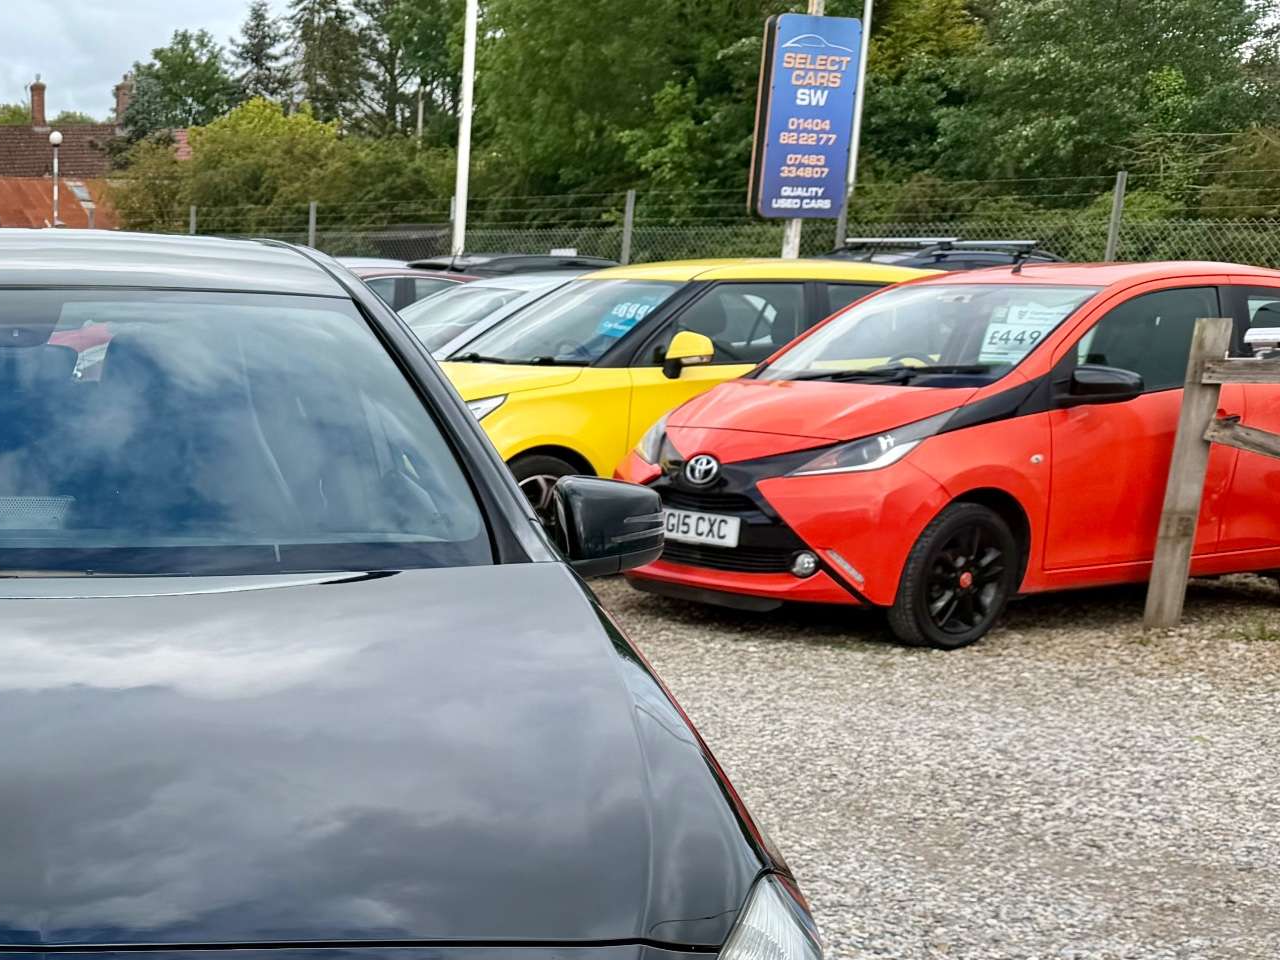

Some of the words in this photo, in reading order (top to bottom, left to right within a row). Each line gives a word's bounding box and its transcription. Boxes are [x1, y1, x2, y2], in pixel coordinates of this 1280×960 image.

[783, 52, 851, 71] SELECT
[791, 70, 842, 88] CARS
[796, 88, 829, 106] SW
[788, 118, 831, 131] 01404
[786, 154, 825, 165] 07483
[781, 186, 825, 197] QUALITY
[772, 198, 801, 208] USED
[802, 199, 832, 209] CARS
[663, 511, 691, 535] G15
[695, 516, 728, 540] CXC
